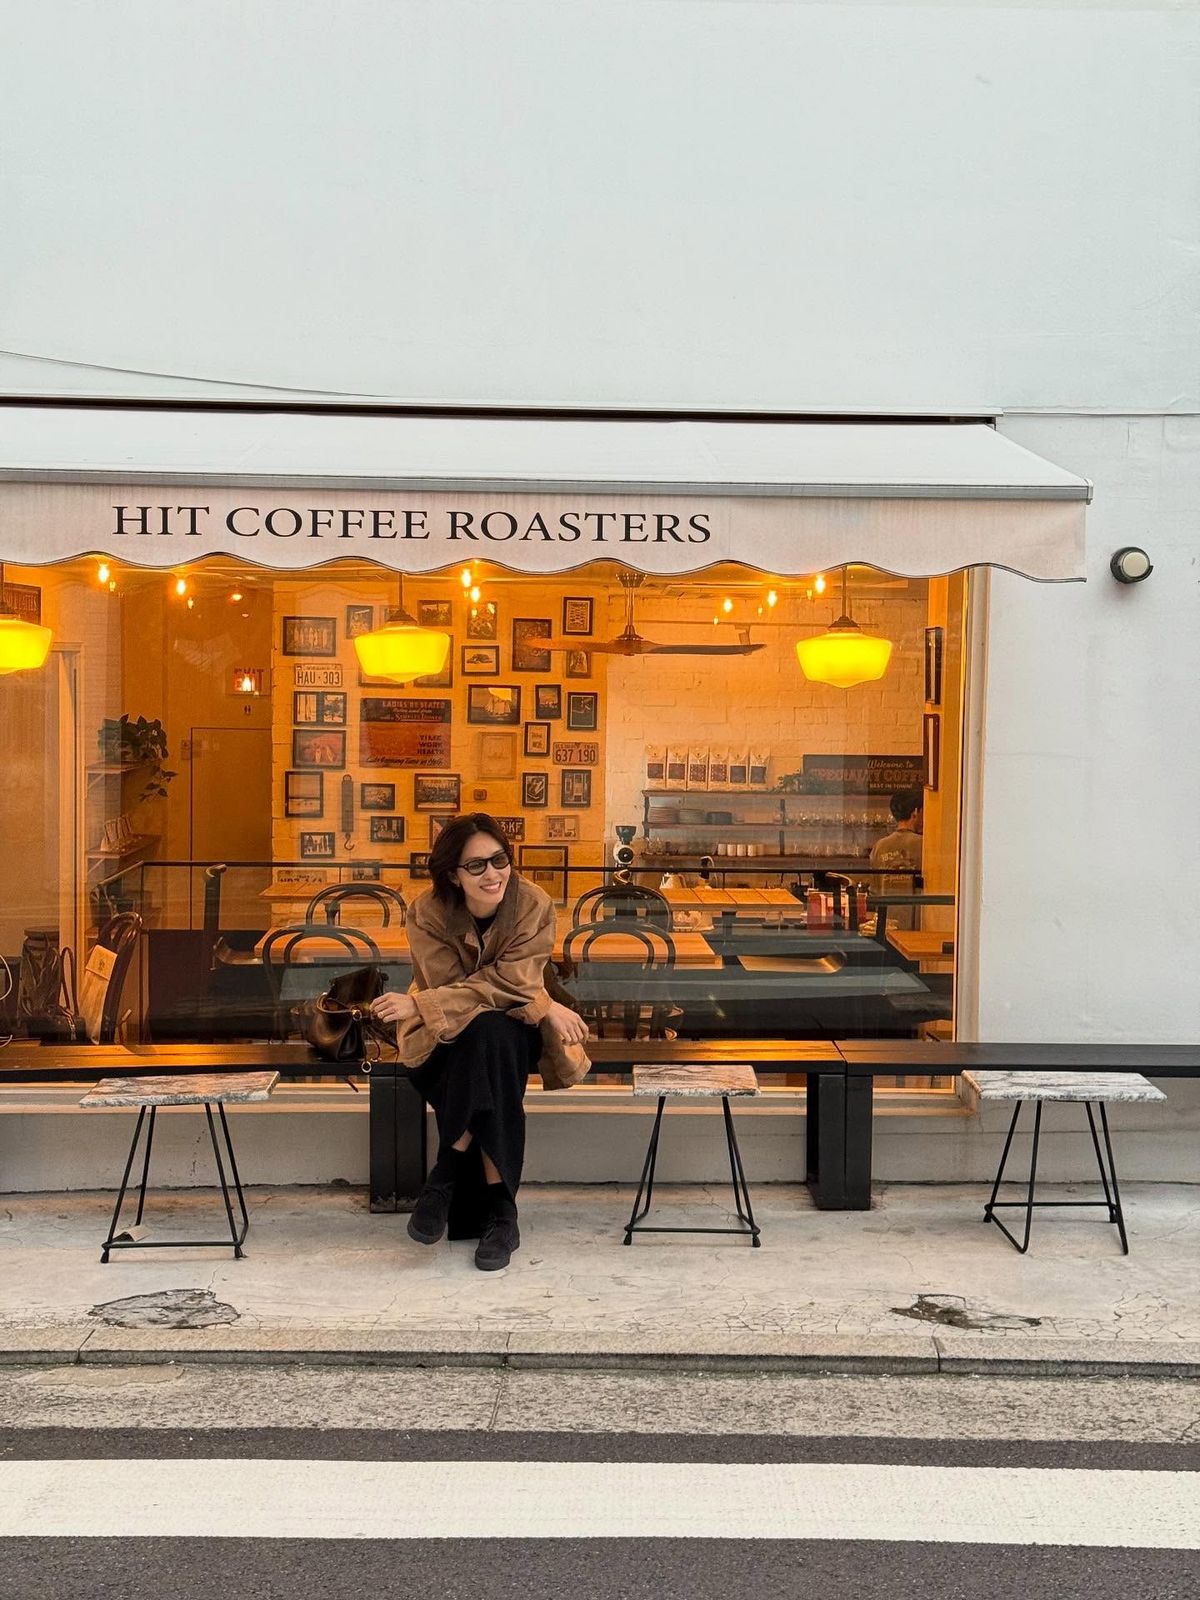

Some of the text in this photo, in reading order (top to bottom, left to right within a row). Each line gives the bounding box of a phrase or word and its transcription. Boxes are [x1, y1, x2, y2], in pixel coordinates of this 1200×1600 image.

[112, 506, 711, 543] HIT COFFEE ROASTERS
[234, 668, 264, 691] EIT
[555, 750, 596, 762] 637 190
[868, 760, 904, 769] Welcome
